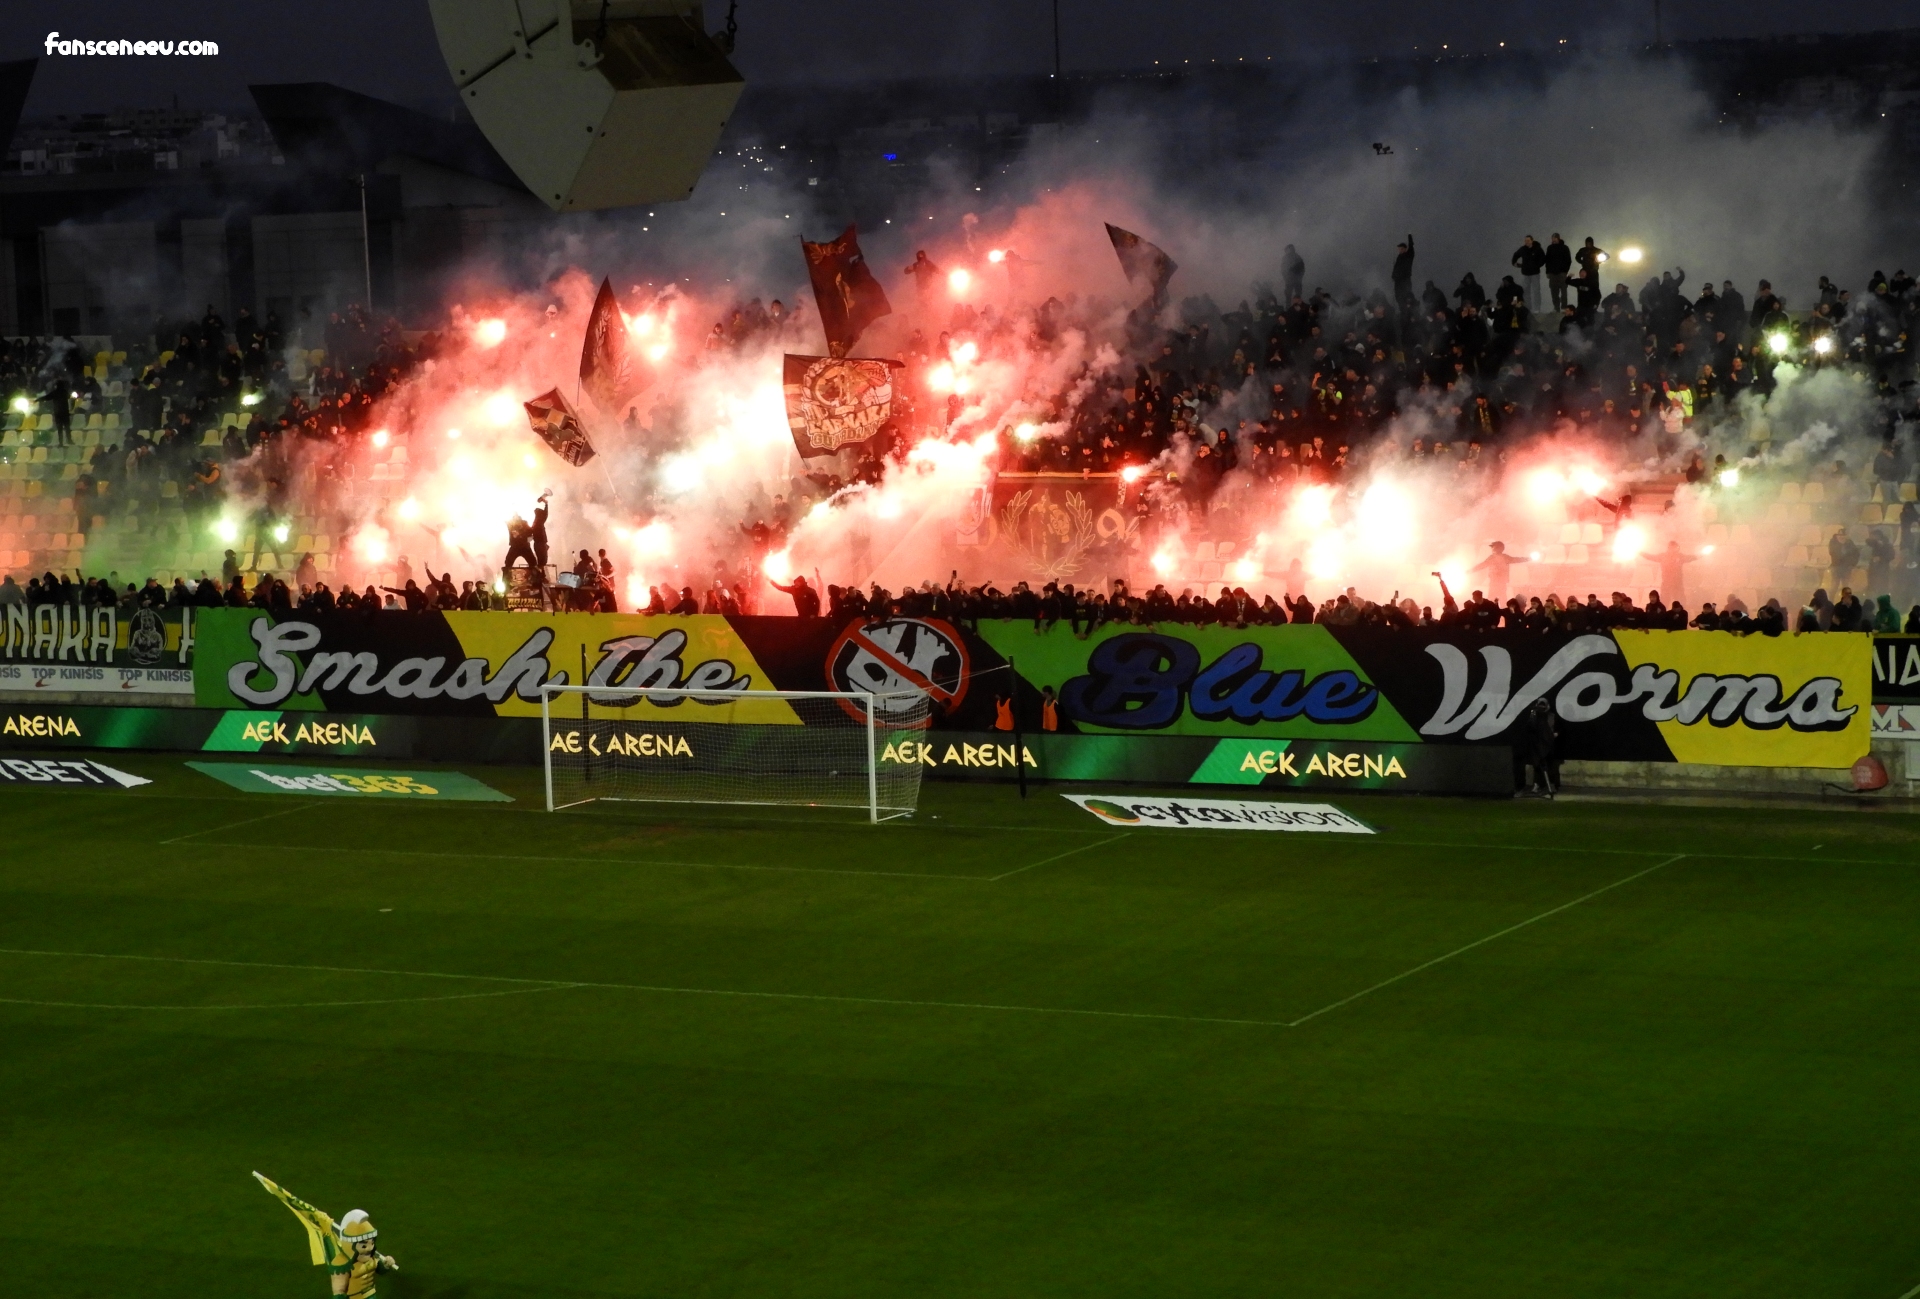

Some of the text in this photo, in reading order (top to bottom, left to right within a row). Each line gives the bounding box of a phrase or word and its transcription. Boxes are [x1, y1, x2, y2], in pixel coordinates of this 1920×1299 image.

[0, 602, 116, 663] NAKA
[32, 667, 56, 680] TOP
[60, 668, 104, 680] KINISIS
[118, 668, 142, 681] TOP
[147, 669, 192, 683] KINISIS
[228, 617, 566, 705] Smash
[1062, 634, 1377, 728] Blue
[1420, 634, 1858, 740] Worms
[3, 714, 81, 737] ARENA
[242, 721, 376, 745] AEK ARENA
[550, 731, 694, 757] AEK ARENA
[881, 741, 1038, 768] AEK ARENA
[1240, 750, 1407, 779] AEK ARENA
[248, 769, 439, 795] bet365
[1131, 801, 1360, 826] cytavision
